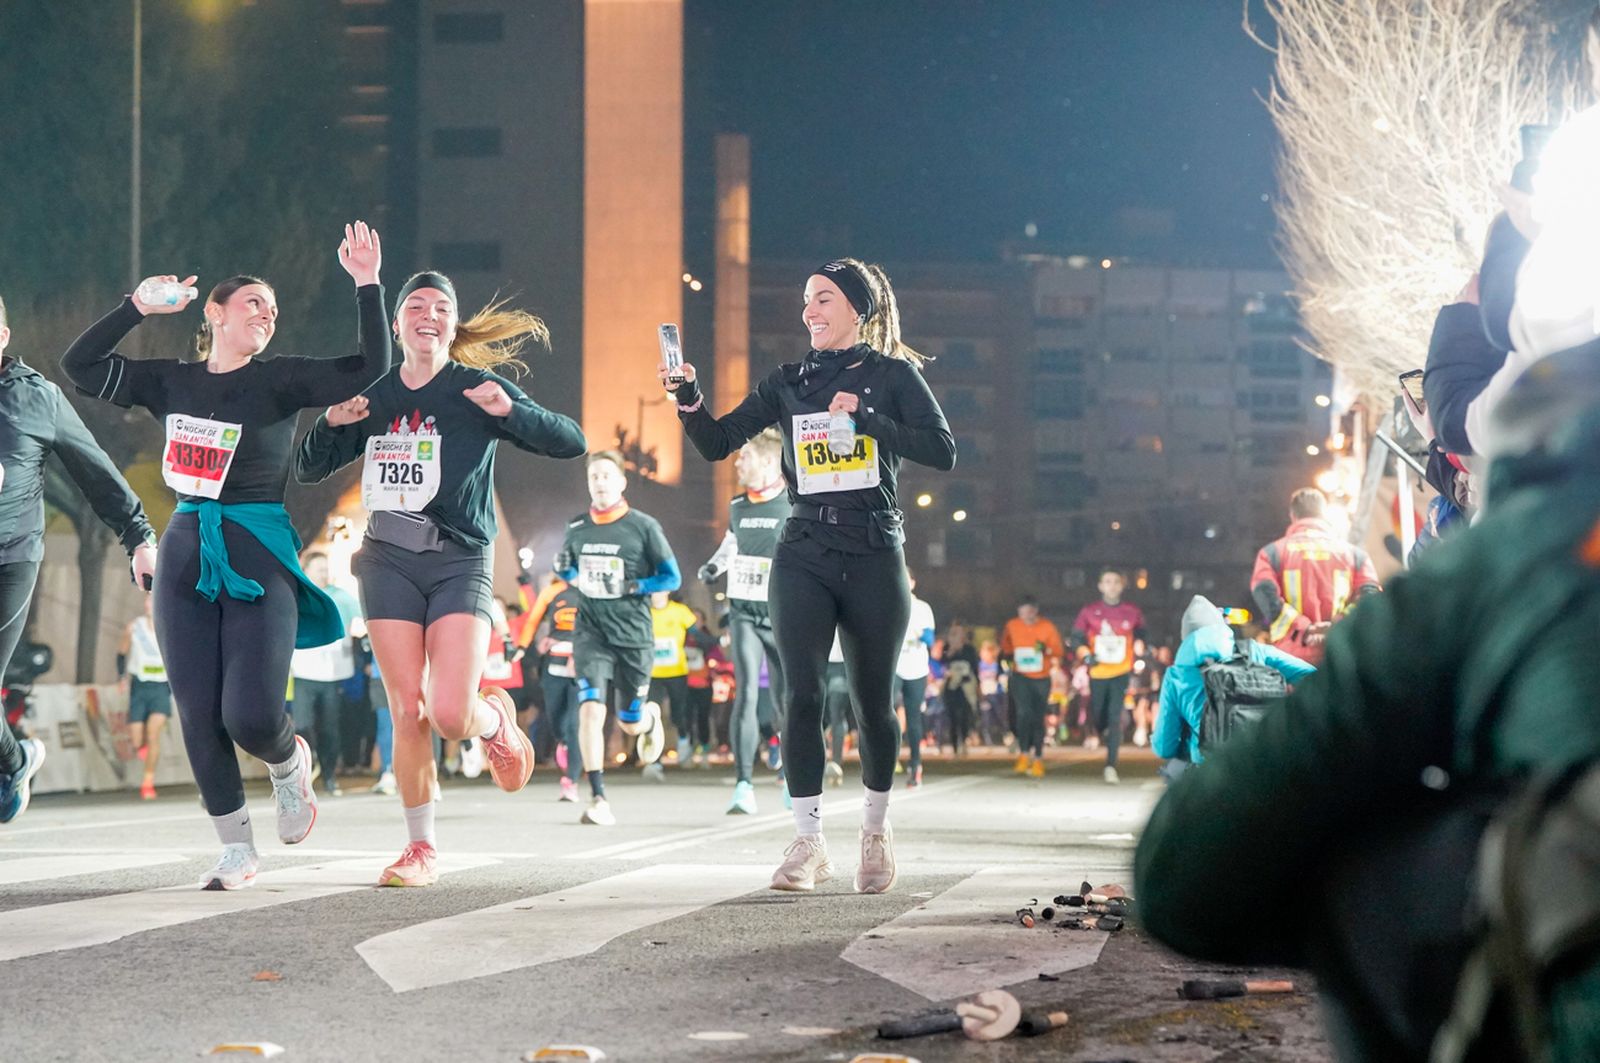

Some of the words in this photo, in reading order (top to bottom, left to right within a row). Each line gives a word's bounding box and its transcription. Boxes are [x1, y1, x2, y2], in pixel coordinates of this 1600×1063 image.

[183, 425, 206, 435] NOCHE
[207, 429, 217, 438] DE
[174, 432, 189, 441] SAN
[801, 432, 816, 442] SAN
[381, 443, 403, 451] NOCHE
[404, 443, 412, 452] DE
[373, 452, 386, 461] SAN
[378, 462, 424, 485] 7326
